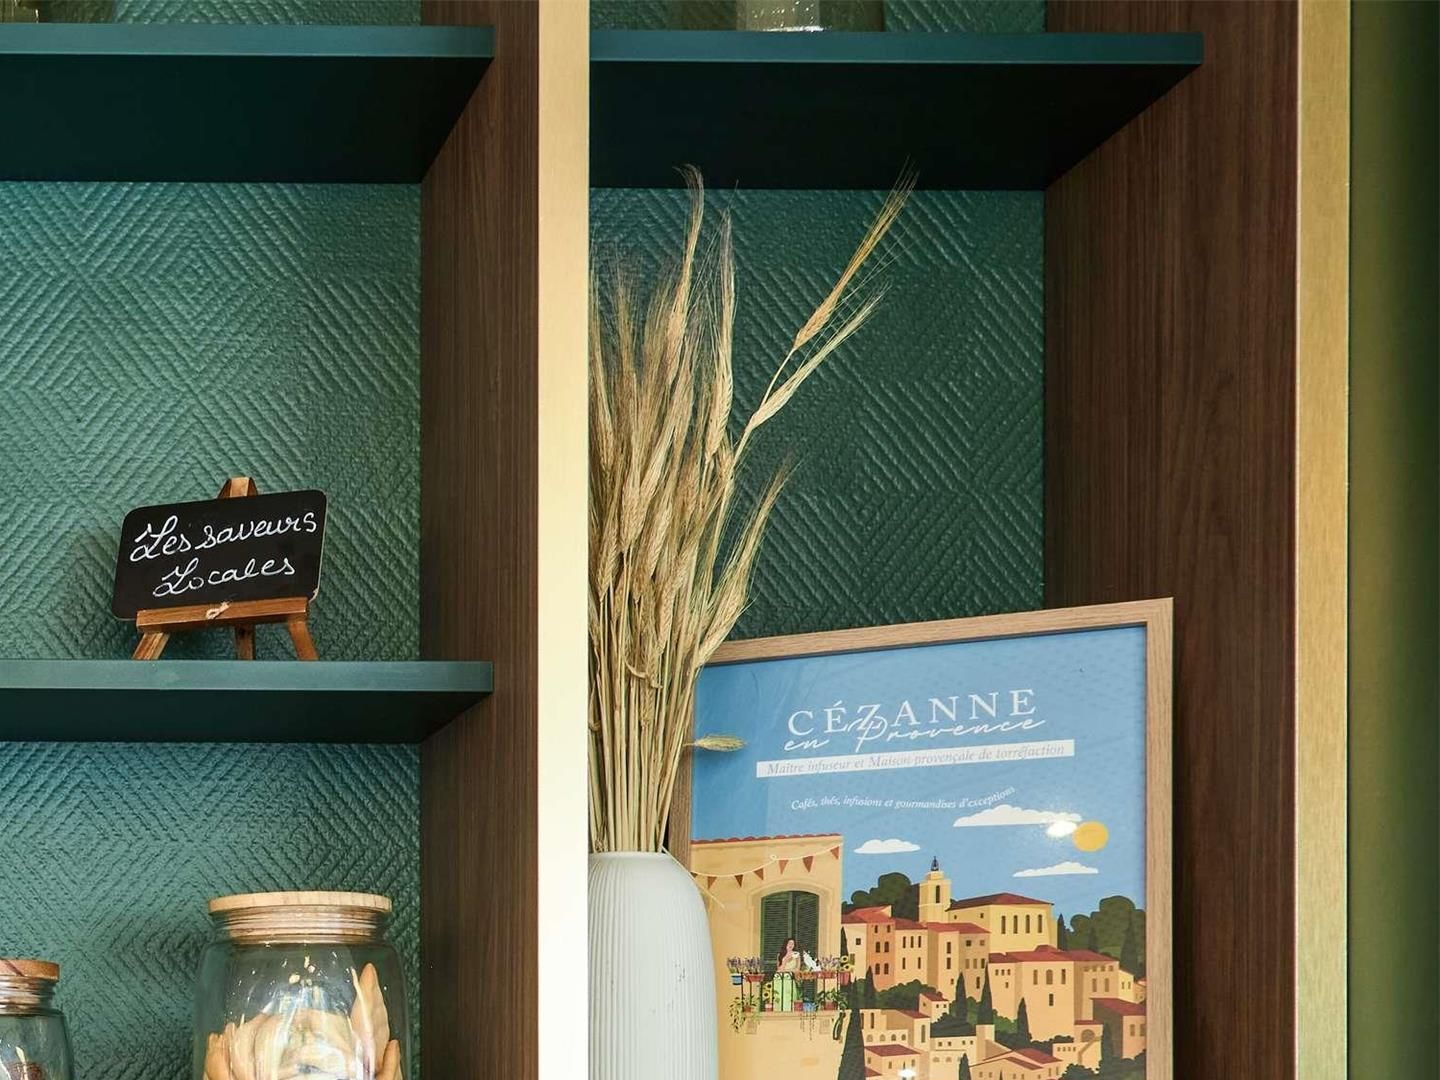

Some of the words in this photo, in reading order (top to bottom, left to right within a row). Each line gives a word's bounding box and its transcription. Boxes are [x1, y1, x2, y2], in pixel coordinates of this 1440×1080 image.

[130, 515, 192, 563] Les
[194, 511, 318, 550] saveurs
[152, 557, 297, 598] Locales
[787, 688, 1036, 736] CÉZANNE
[783, 738, 830, 751] en
[847, 714, 1046, 753] Provence
[766, 761, 804, 775] Maître
[807, 758, 851, 774] infuseur
[854, 758, 864, 768] et
[868, 753, 912, 768] Maison
[913, 749, 974, 766] provençale
[978, 749, 993, 760] de
[995, 743, 1065, 760] torréfaction
[790, 798, 818, 811] Cafés,
[820, 795, 841, 806] thés,
[843, 794, 882, 808] infusions
[884, 798, 893, 807] et
